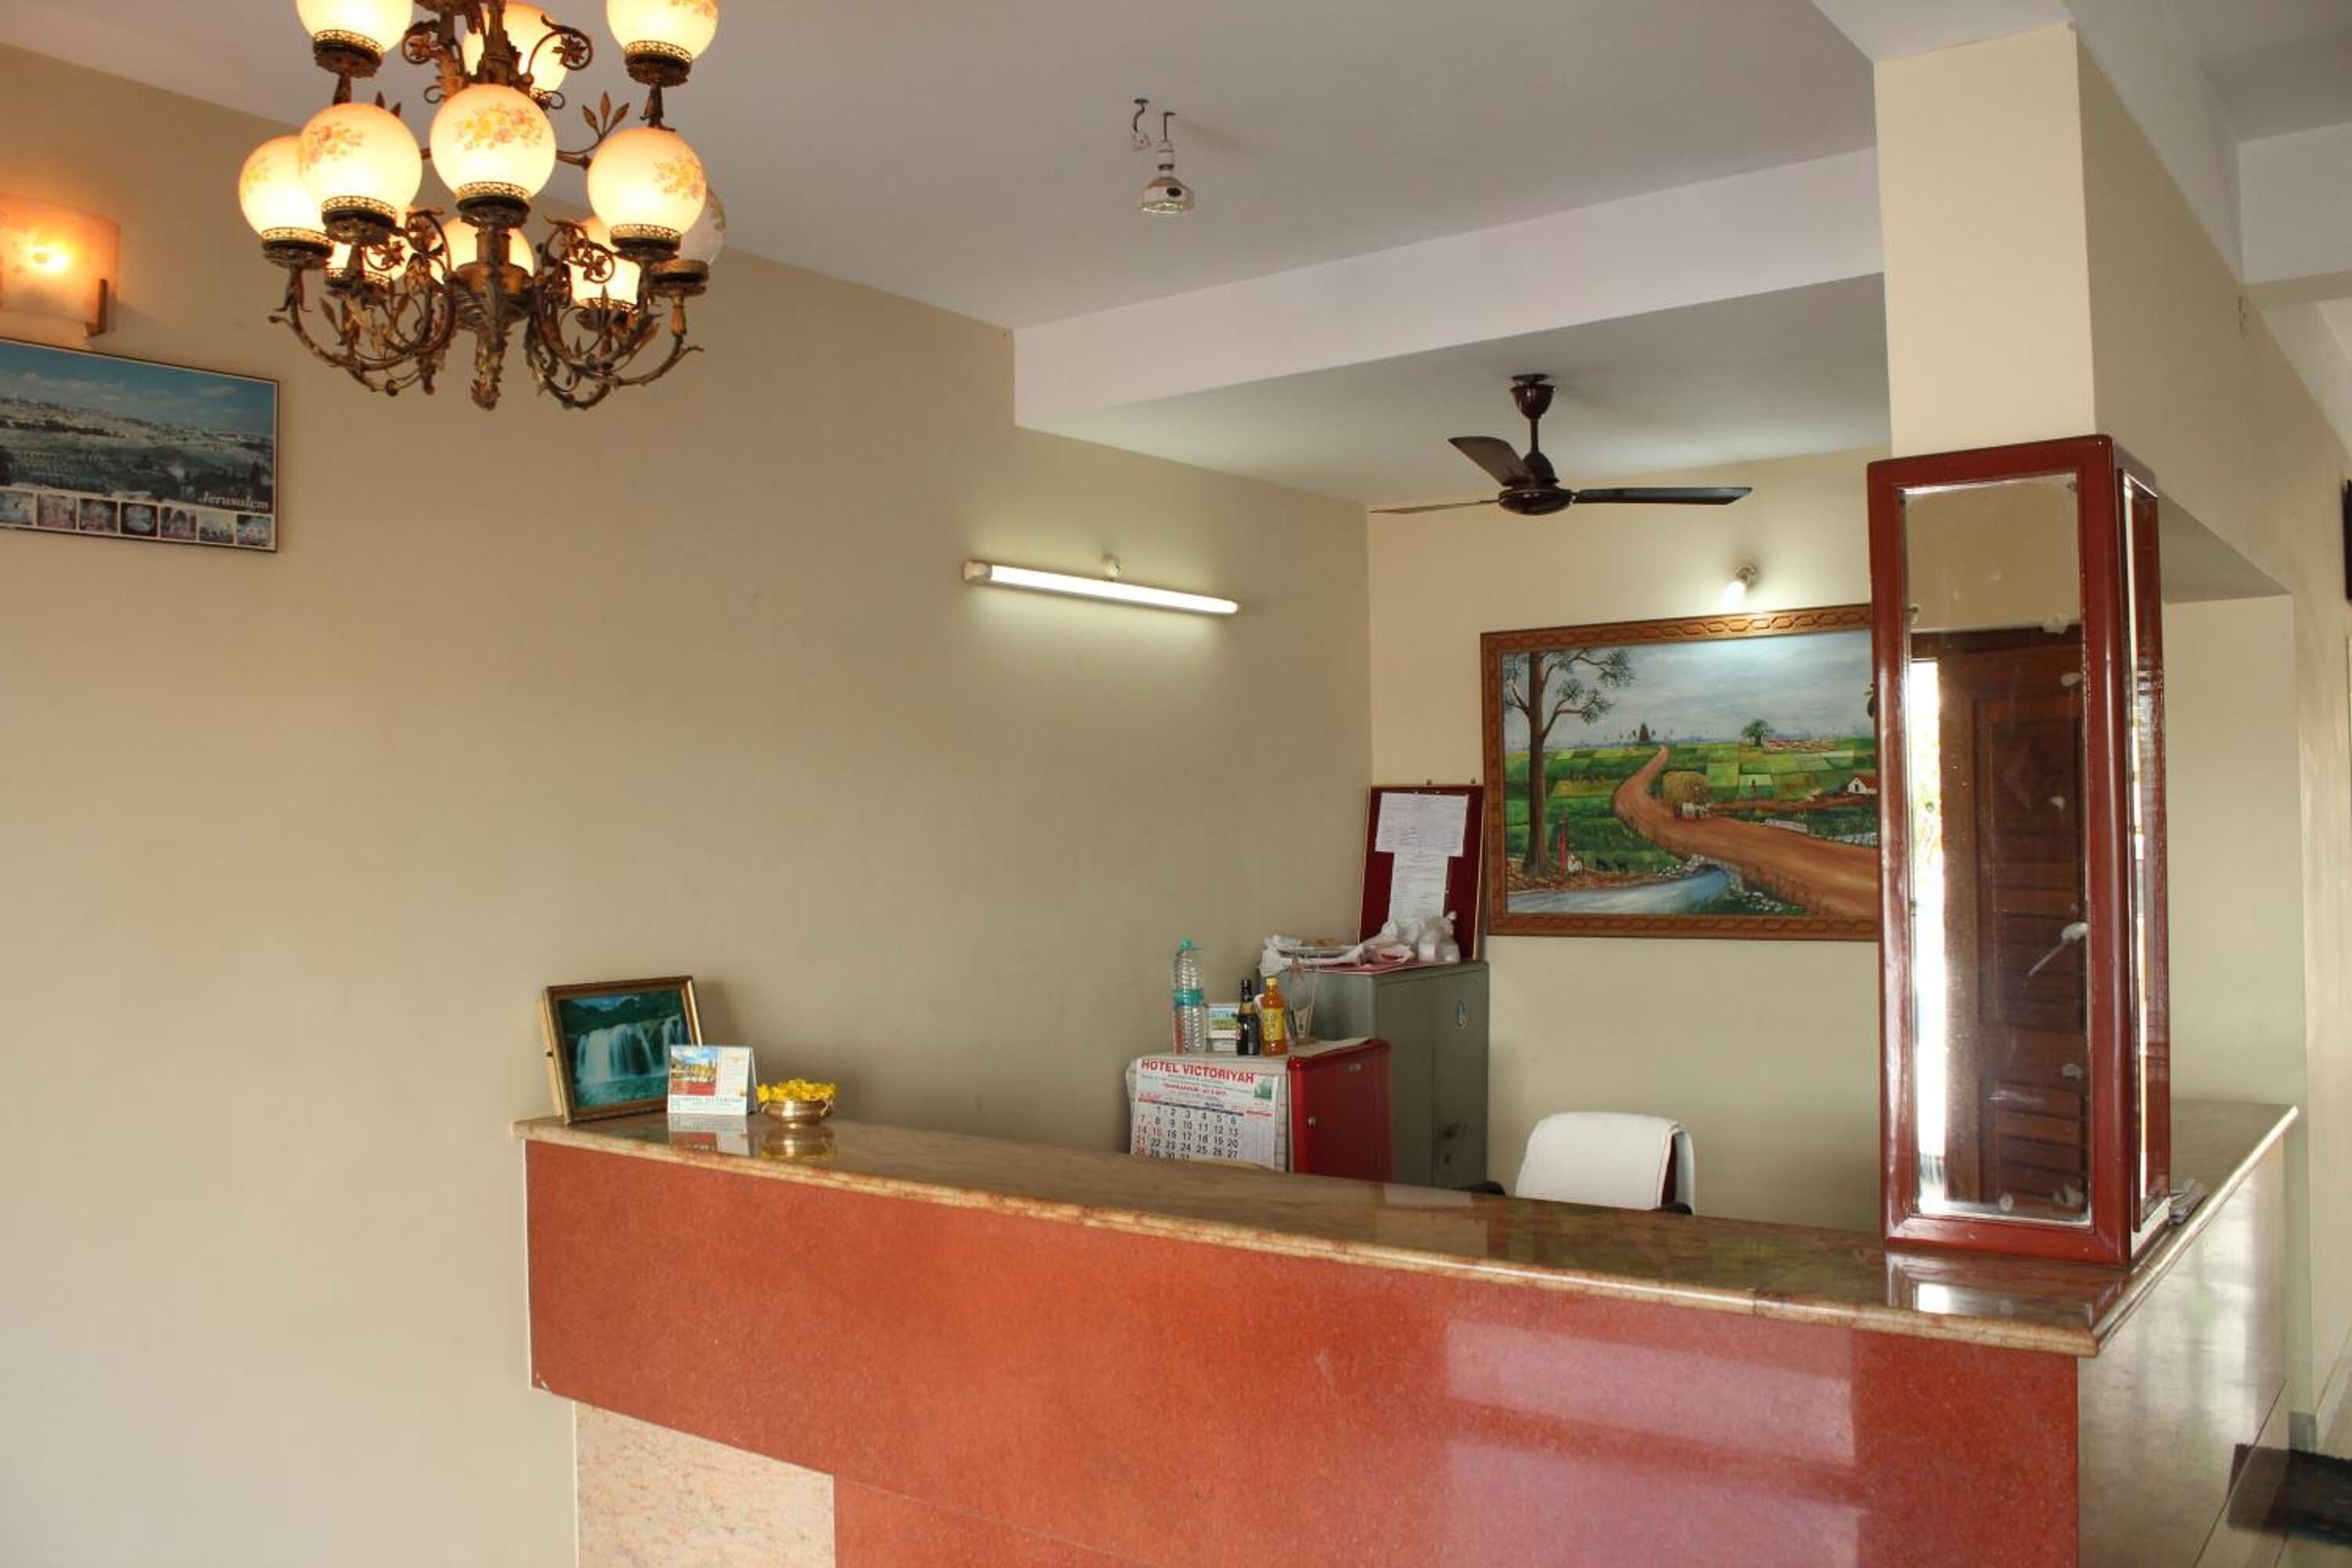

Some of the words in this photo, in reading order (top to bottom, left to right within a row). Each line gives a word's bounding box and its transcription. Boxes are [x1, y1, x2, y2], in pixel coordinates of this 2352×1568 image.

[198, 491, 269, 509] Jerusalem
[1141, 1059, 1179, 1073] HOTEL
[1182, 1065, 1254, 1083] VICTORIYAH
[1155, 1116, 1160, 1125] 8
[1171, 1119, 1175, 1128] 9
[1183, 1120, 1192, 1130] 10
[1199, 1123, 1208, 1131] 11
[1214, 1125, 1223, 1134] 12
[1229, 1128, 1238, 1138] 13
[1185, 1109, 1191, 1119] 3
[1200, 1112, 1207, 1120] 4
[1216, 1114, 1222, 1123] 5
[1230, 1116, 1236, 1125] 6
[1136, 1135, 1145, 1145] 21
[1150, 1138, 1160, 1147] 22
[1165, 1140, 1175, 1150] 23
[1180, 1142, 1191, 1152] 24
[1196, 1144, 1207, 1155] 25
[1213, 1147, 1223, 1157] 26
[1227, 1149, 1238, 1160] 27
[1138, 1125, 1147, 1134] 14
[1153, 1127, 1162, 1137] 15
[1167, 1130, 1177, 1139] 16
[1183, 1131, 1192, 1141] 17
[1199, 1134, 1208, 1143] 18
[1214, 1136, 1224, 1145] 19
[1227, 1138, 1239, 1149] 20
[1134, 1145, 1145, 1156] 28
